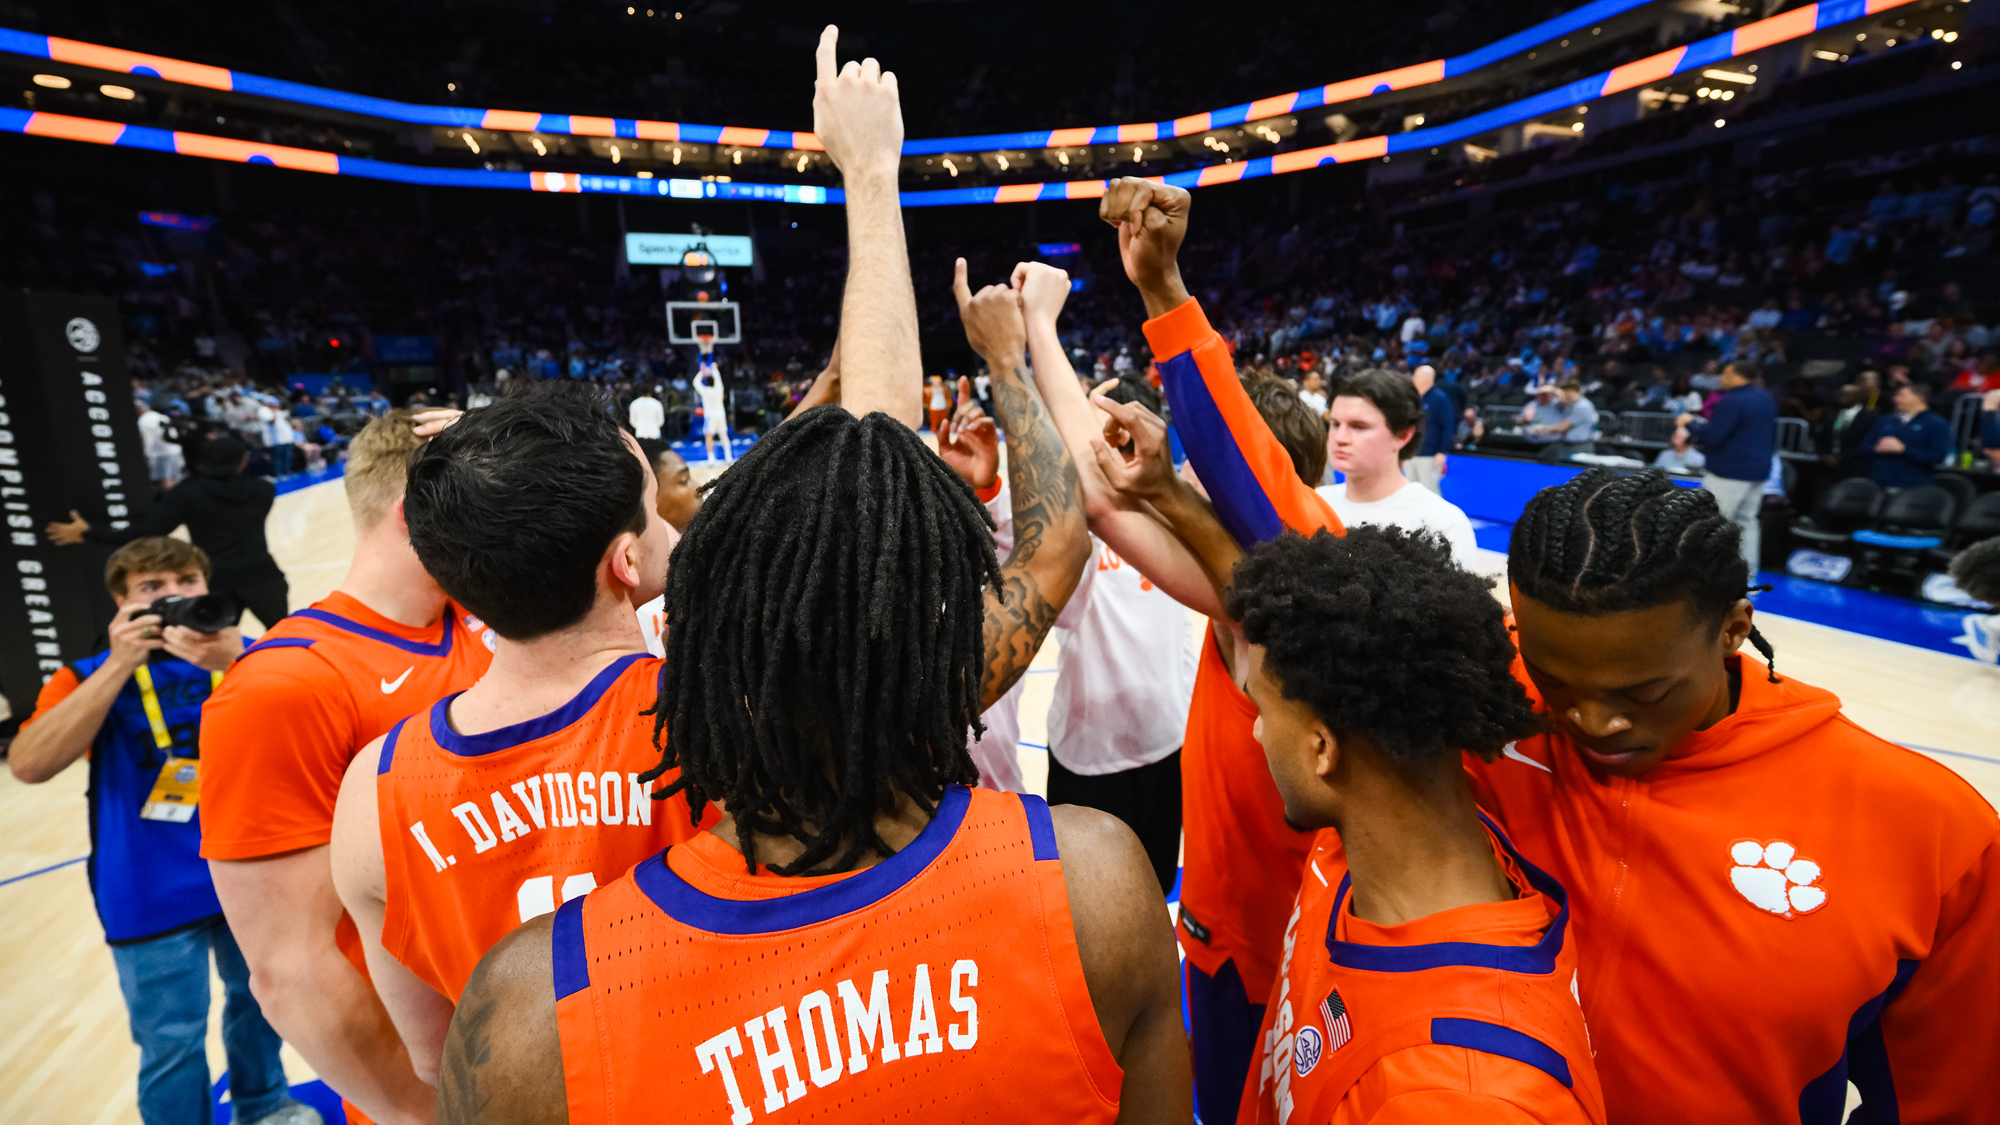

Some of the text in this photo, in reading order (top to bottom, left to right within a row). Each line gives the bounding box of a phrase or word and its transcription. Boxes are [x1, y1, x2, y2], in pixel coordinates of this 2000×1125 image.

[451, 771, 655, 854] DAVIDSON
[694, 959, 979, 1125] THOMAS
[1301, 1036, 1315, 1069] ACC
